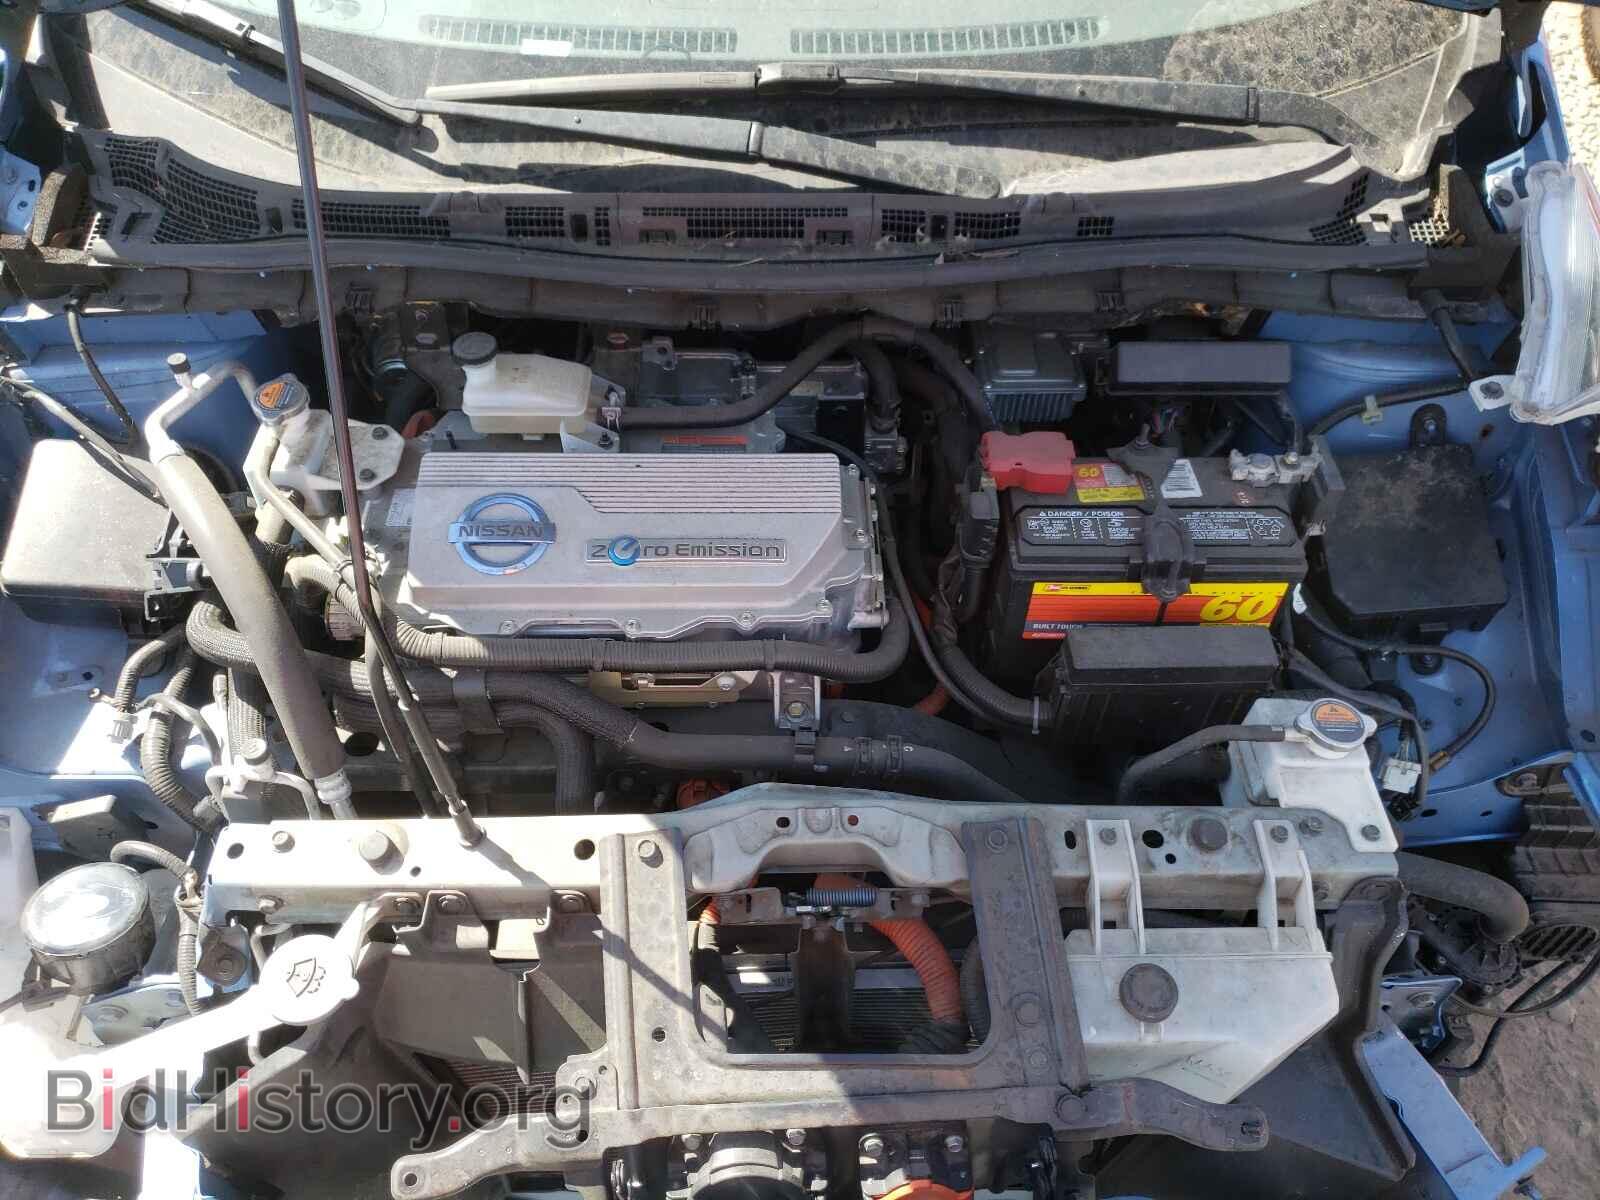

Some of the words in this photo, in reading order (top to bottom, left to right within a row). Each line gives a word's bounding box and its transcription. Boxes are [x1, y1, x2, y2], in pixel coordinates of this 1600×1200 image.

[1079, 467, 1100, 478] 60
[459, 524, 543, 538] NISSAN
[675, 542, 781, 557] Emission
[1200, 590, 1279, 622] 60
